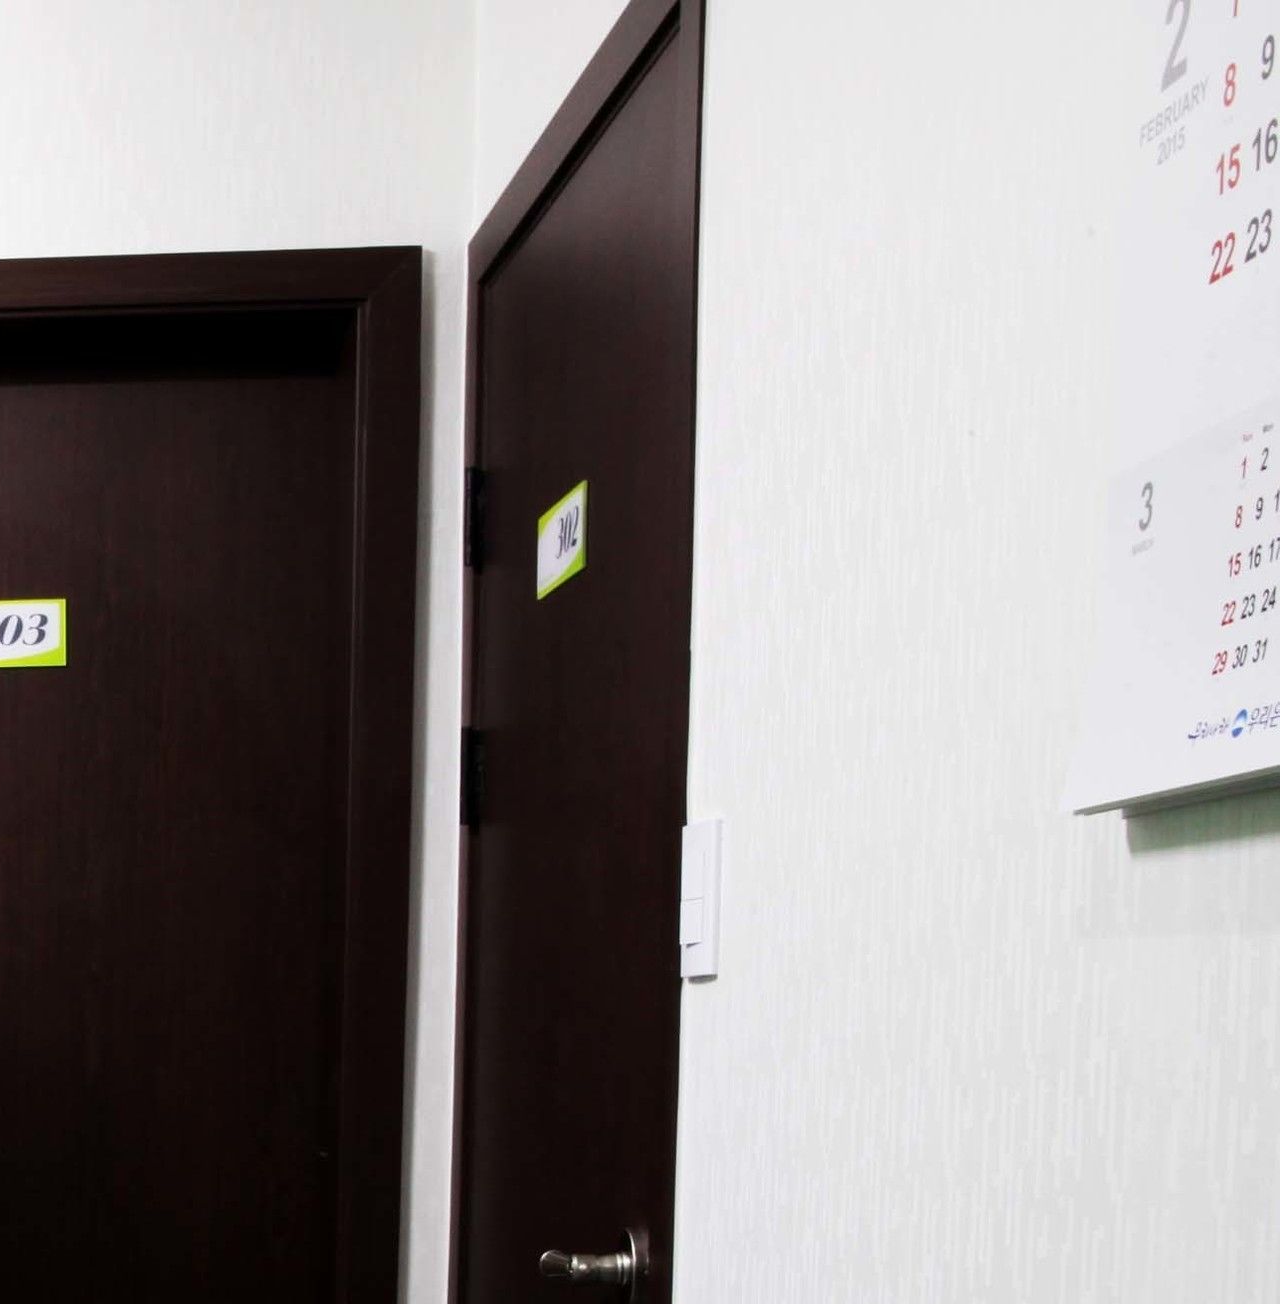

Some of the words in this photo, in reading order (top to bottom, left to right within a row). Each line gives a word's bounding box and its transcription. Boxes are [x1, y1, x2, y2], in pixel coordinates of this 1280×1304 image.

[1160, 0, 1191, 92] 2
[1223, 63, 1236, 107] 8
[1262, 34, 1275, 80] 9
[1139, 74, 1209, 147] FEBRUARY
[1157, 125, 1186, 166] 2015
[1216, 144, 1240, 195] 15
[1252, 119, 1278, 172] 16
[1209, 232, 1236, 285] 22
[1244, 208, 1273, 263] 23
[1241, 456, 1247, 479] 1
[1260, 447, 1269, 471] 2
[1139, 481, 1153, 531] 3
[1235, 505, 1243, 529] 8
[1255, 497, 1264, 521] 9
[555, 505, 579, 559] 302
[1228, 552, 1242, 577] 15
[1248, 544, 1262, 570] 16
[1221, 600, 1236, 626] 22
[1240, 593, 1256, 620] 23
[1261, 585, 1277, 614] 24
[1212, 650, 1228, 675] 29
[1232, 643, 1248, 669] 30
[1252, 637, 1268, 663] 31
